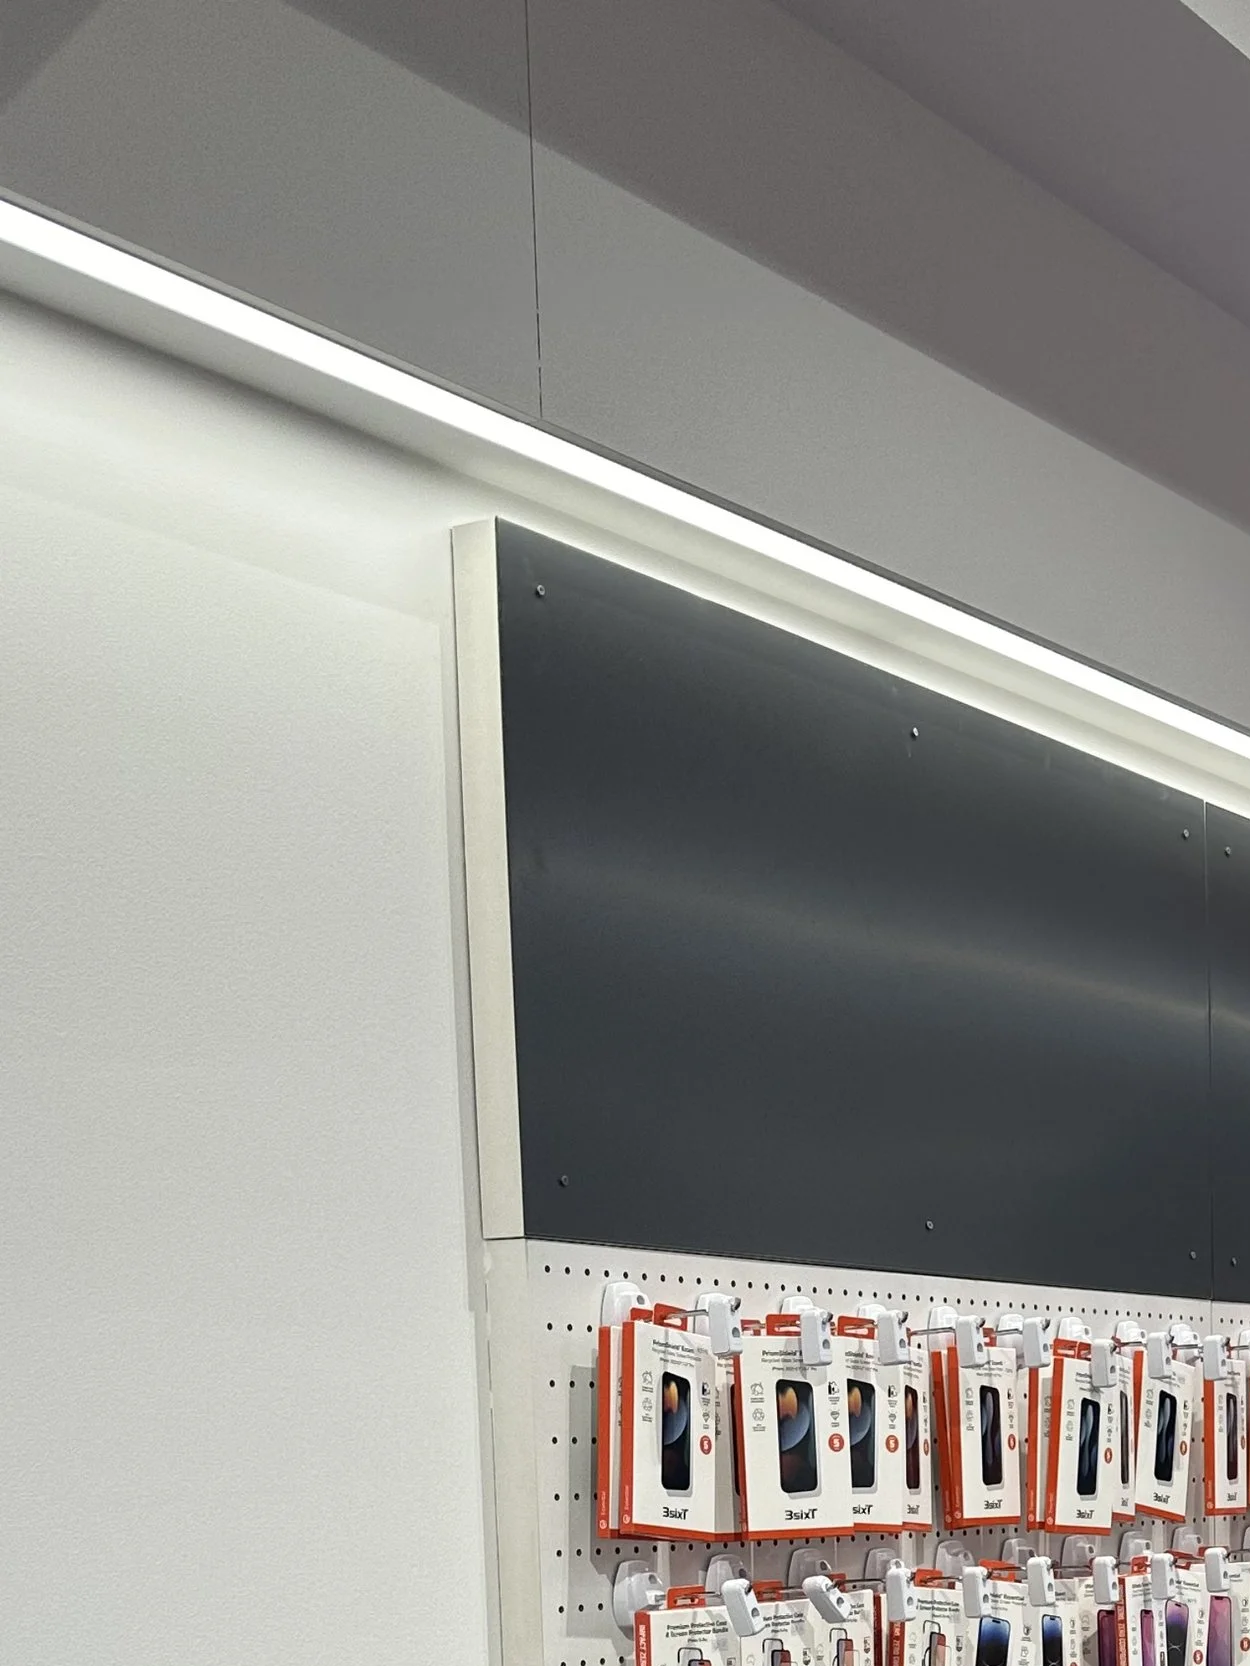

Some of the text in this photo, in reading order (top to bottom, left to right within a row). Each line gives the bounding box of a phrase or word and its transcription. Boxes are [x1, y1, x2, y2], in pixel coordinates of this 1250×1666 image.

[662, 1506, 689, 1520] 3sixT
[784, 1508, 818, 1521] 3sixT
[852, 1504, 873, 1516] sixT
